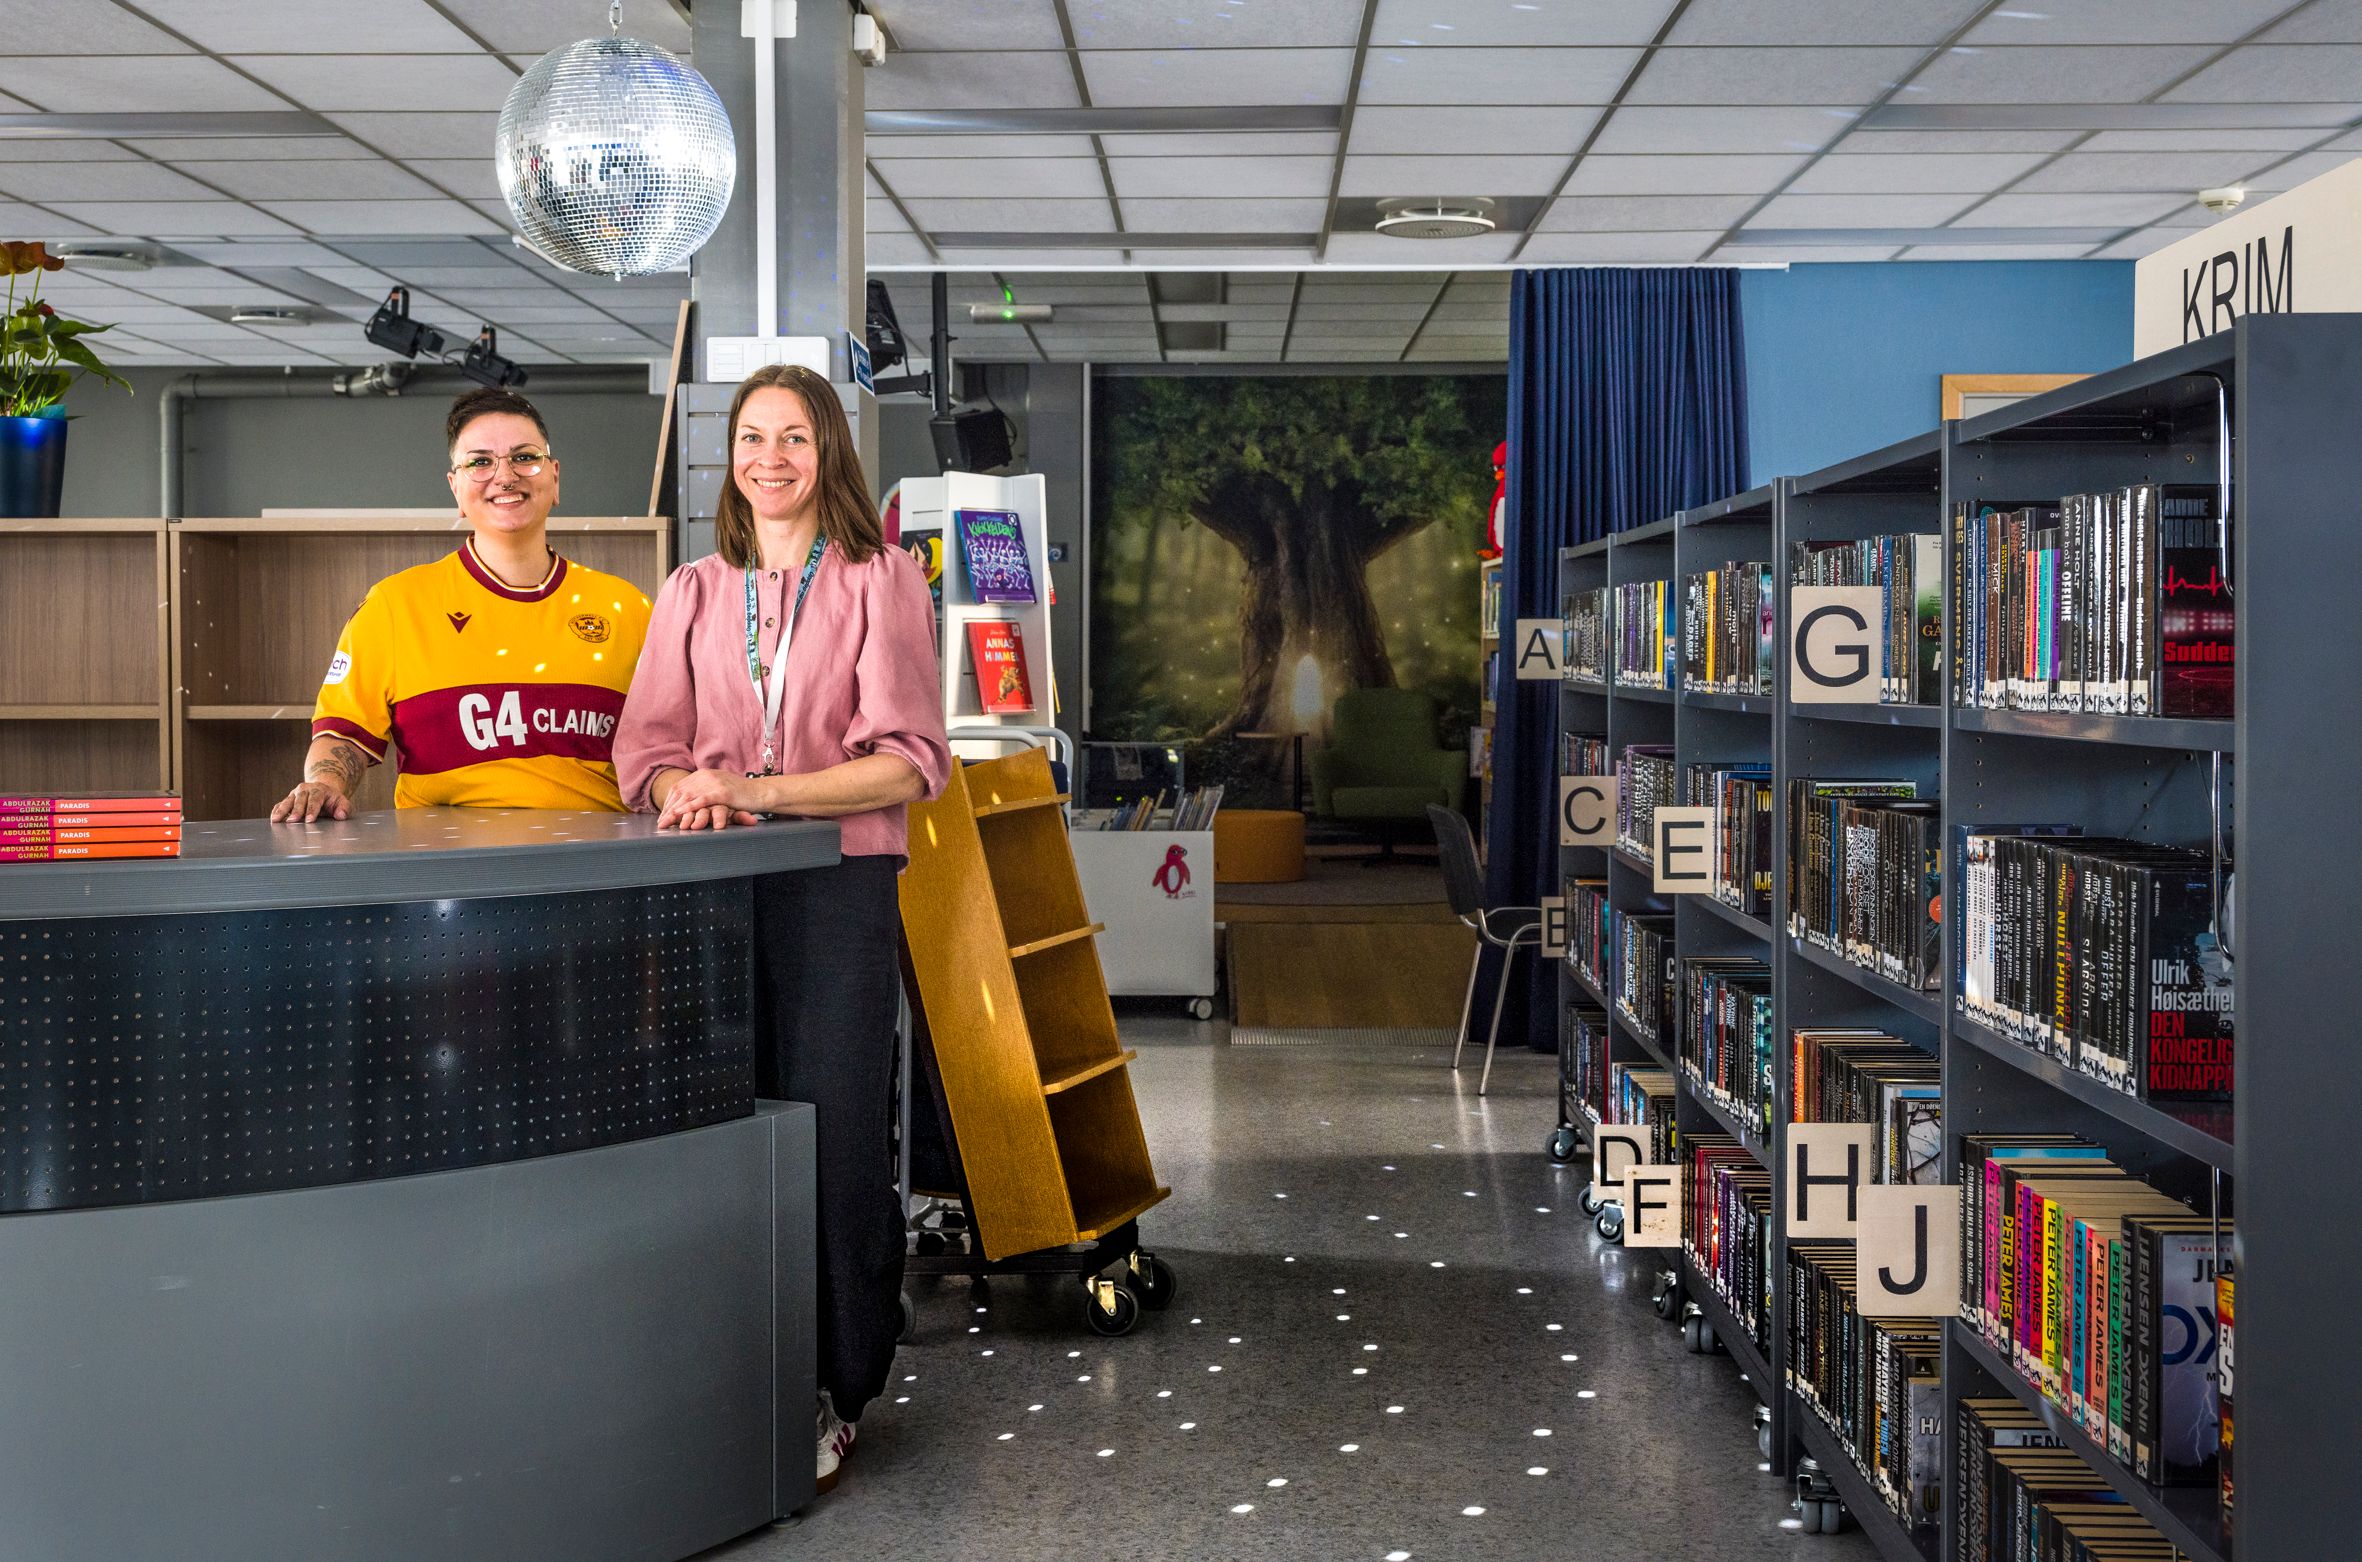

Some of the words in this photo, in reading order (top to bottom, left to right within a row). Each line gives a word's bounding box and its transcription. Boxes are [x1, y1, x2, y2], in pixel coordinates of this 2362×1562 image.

[2183, 225, 2293, 345] KRIM
[2061, 571, 2072, 622] OFFLINE
[986, 637, 1015, 649] ANNAS
[1518, 627, 1556, 670] A
[1795, 604, 1869, 688] G
[458, 690, 528, 751] G4
[533, 708, 615, 738] CLAIMS
[1564, 786, 1606, 835] C
[1661, 821, 1707, 880] E
[2081, 938, 2089, 1018] SLAGSIDE
[2100, 950, 2108, 1001] OFFER
[2152, 959, 2190, 985] Ulrik
[2151, 1012, 2185, 1037] DEN
[1600, 1136, 1643, 1187] D
[1796, 1143, 1859, 1222] H
[1633, 1179, 1671, 1235] F
[2034, 1201, 2042, 1265] PETER
[1878, 1205, 1928, 1295] J
[2002, 1215, 2014, 1266] PETER
[2048, 1207, 2056, 1272] PETER
[2001, 1270, 2013, 1320] JAMES
[2033, 1269, 2041, 1333] JAMES
[2096, 1243, 2105, 1312] PETER
[2112, 1250, 2120, 1321] PETER
[2047, 1275, 2055, 1341] JAMES
[2074, 1298, 2082, 1368] JAMES
[1876, 1330, 1882, 1350] MO
[1882, 1336, 1889, 1357] MO
[2096, 1316, 2104, 1389] JAMES
[2111, 1325, 2119, 1400] JAMES
[1894, 1360, 1899, 1382] MO
[1881, 1418, 1889, 1455] KUREN
